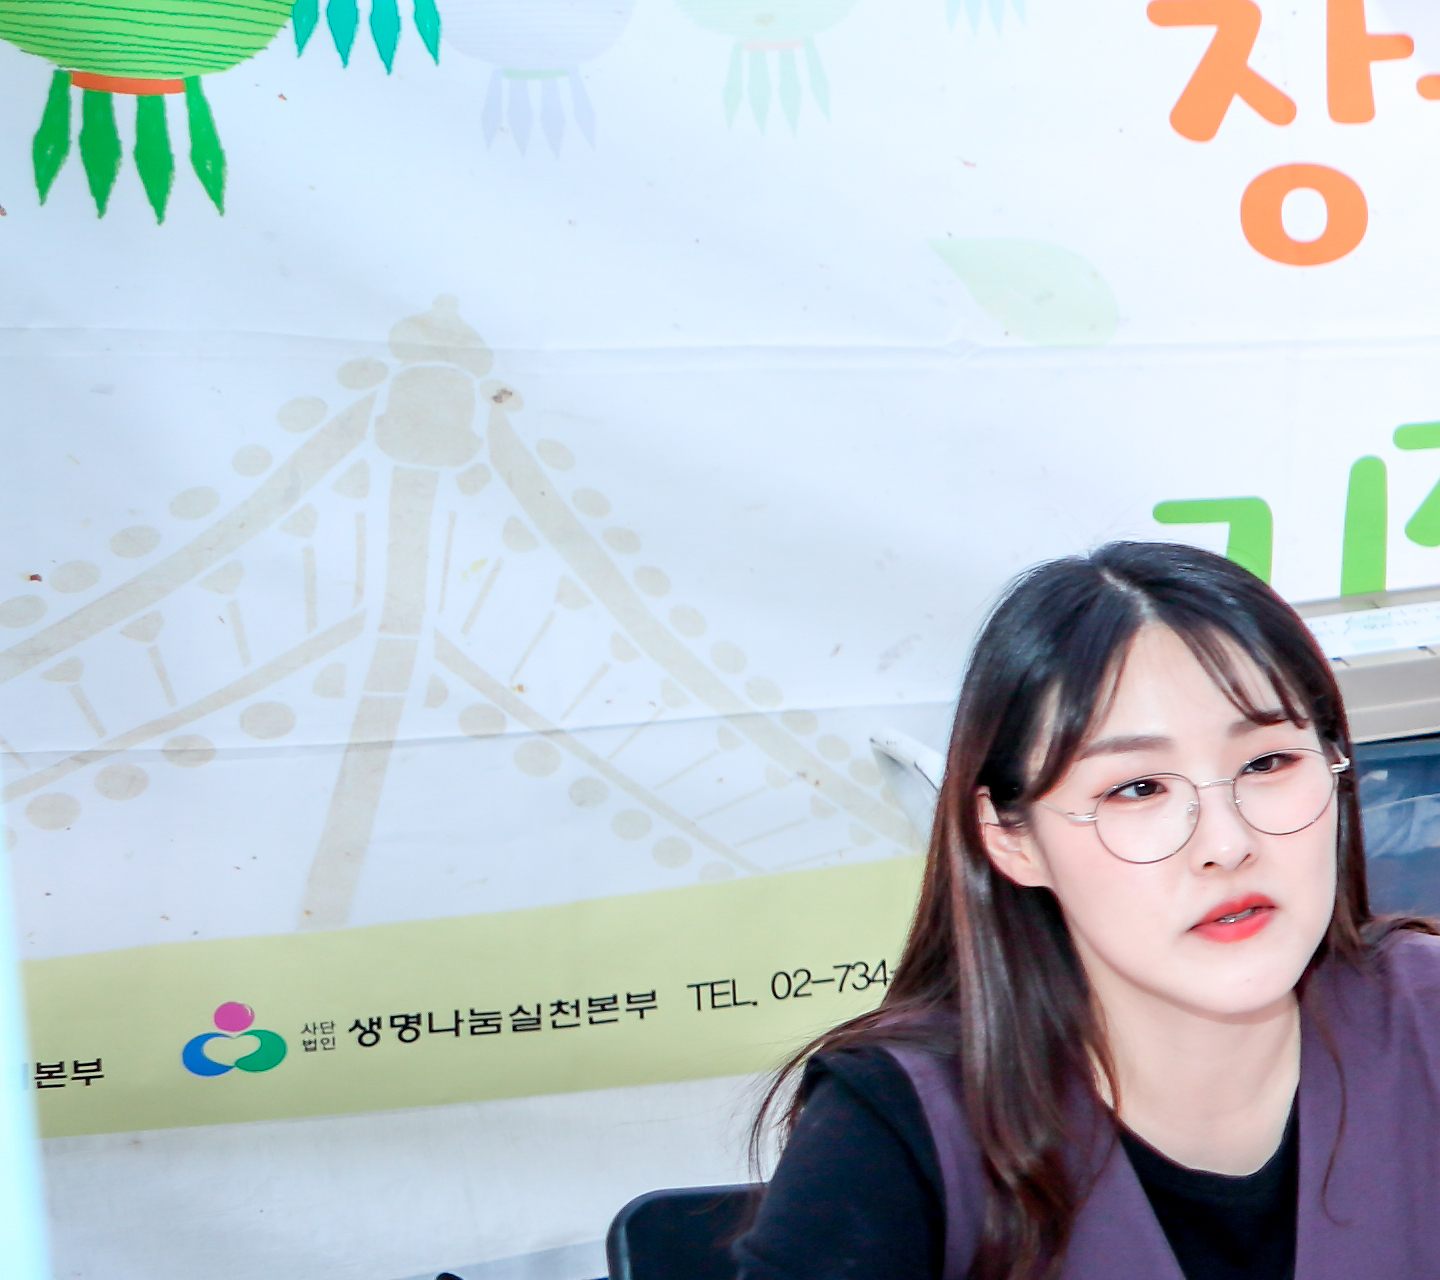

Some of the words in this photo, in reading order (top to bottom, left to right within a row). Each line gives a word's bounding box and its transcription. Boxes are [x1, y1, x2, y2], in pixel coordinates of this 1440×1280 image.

[347, 989, 660, 1048] 생명나눔실천본부
[686, 977, 758, 1012] TEL.
[301, 1020, 336, 1036] 사단
[302, 1036, 337, 1053] 법인
[24, 1056, 105, 1090] 본부
